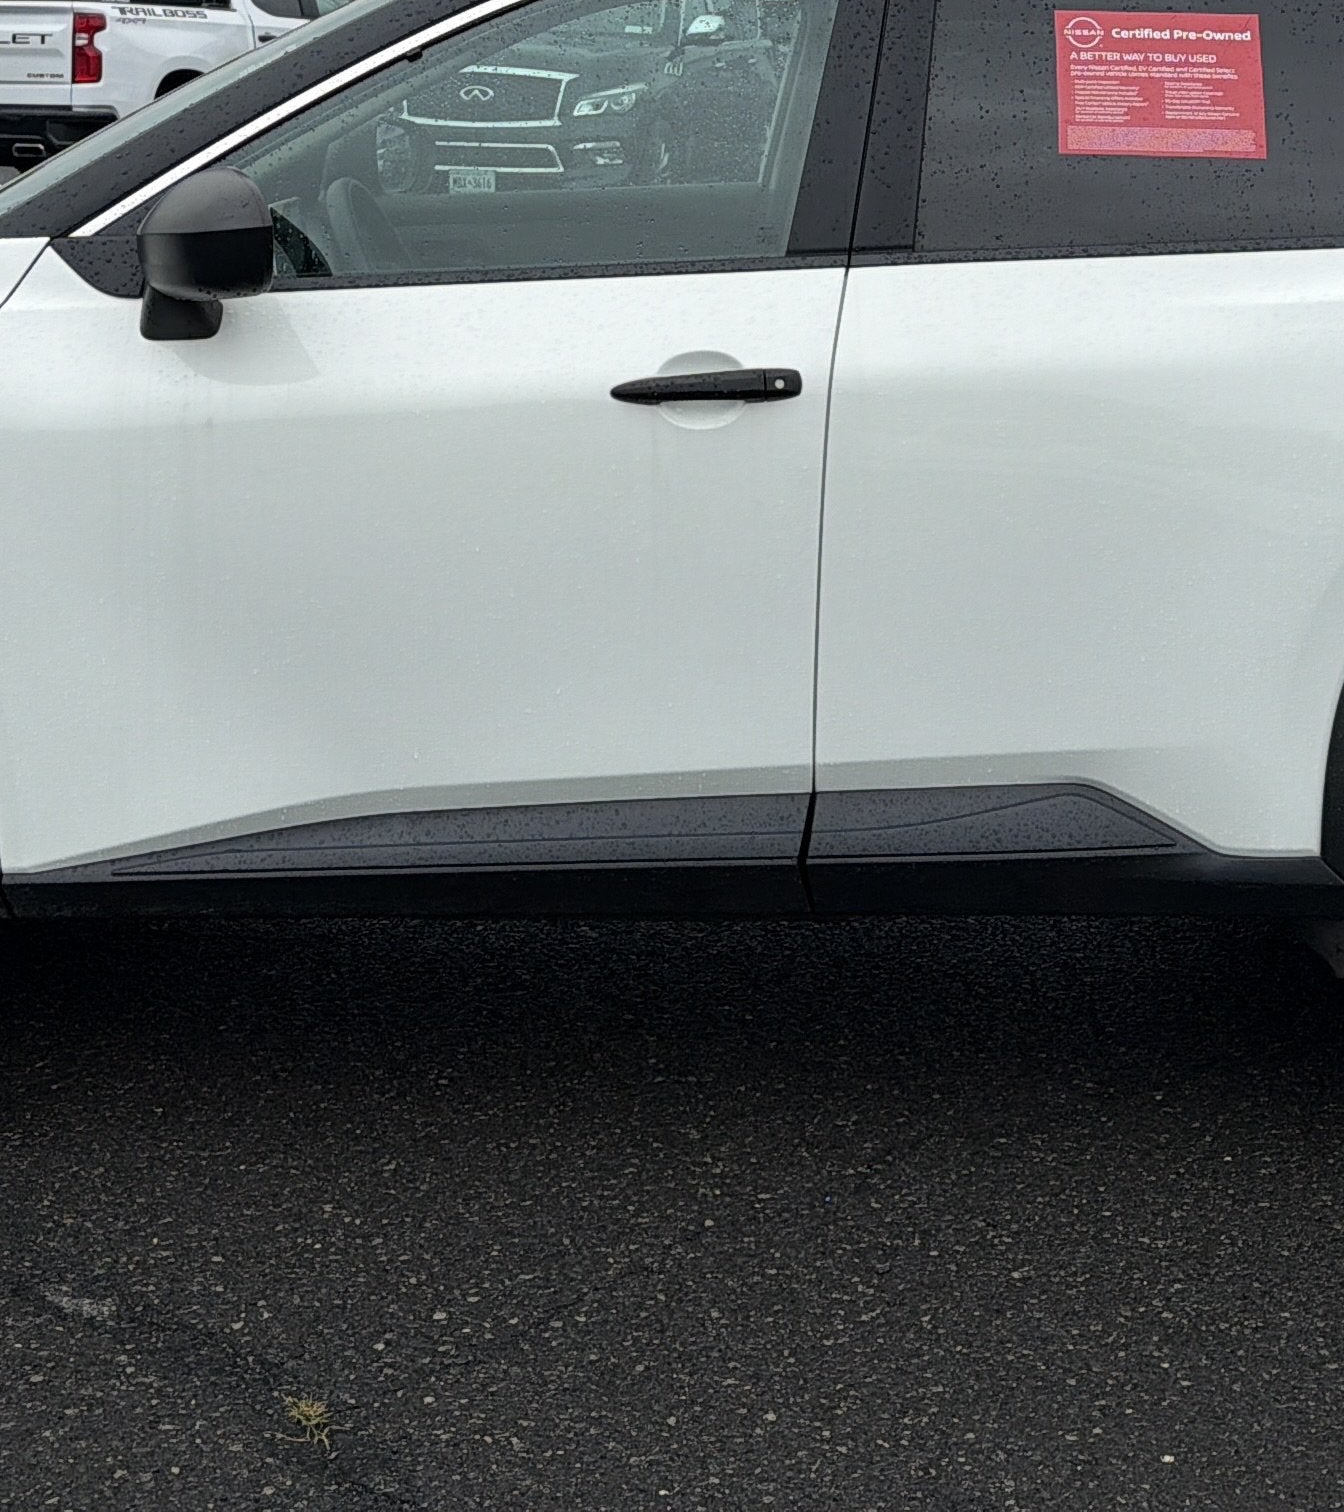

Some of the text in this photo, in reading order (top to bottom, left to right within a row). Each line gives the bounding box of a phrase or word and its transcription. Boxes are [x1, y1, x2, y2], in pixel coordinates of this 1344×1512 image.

[1111, 27, 1251, 41] Certified Pre-Owned
[1070, 51, 1217, 63] A BETTER WAY TO BUY USED
